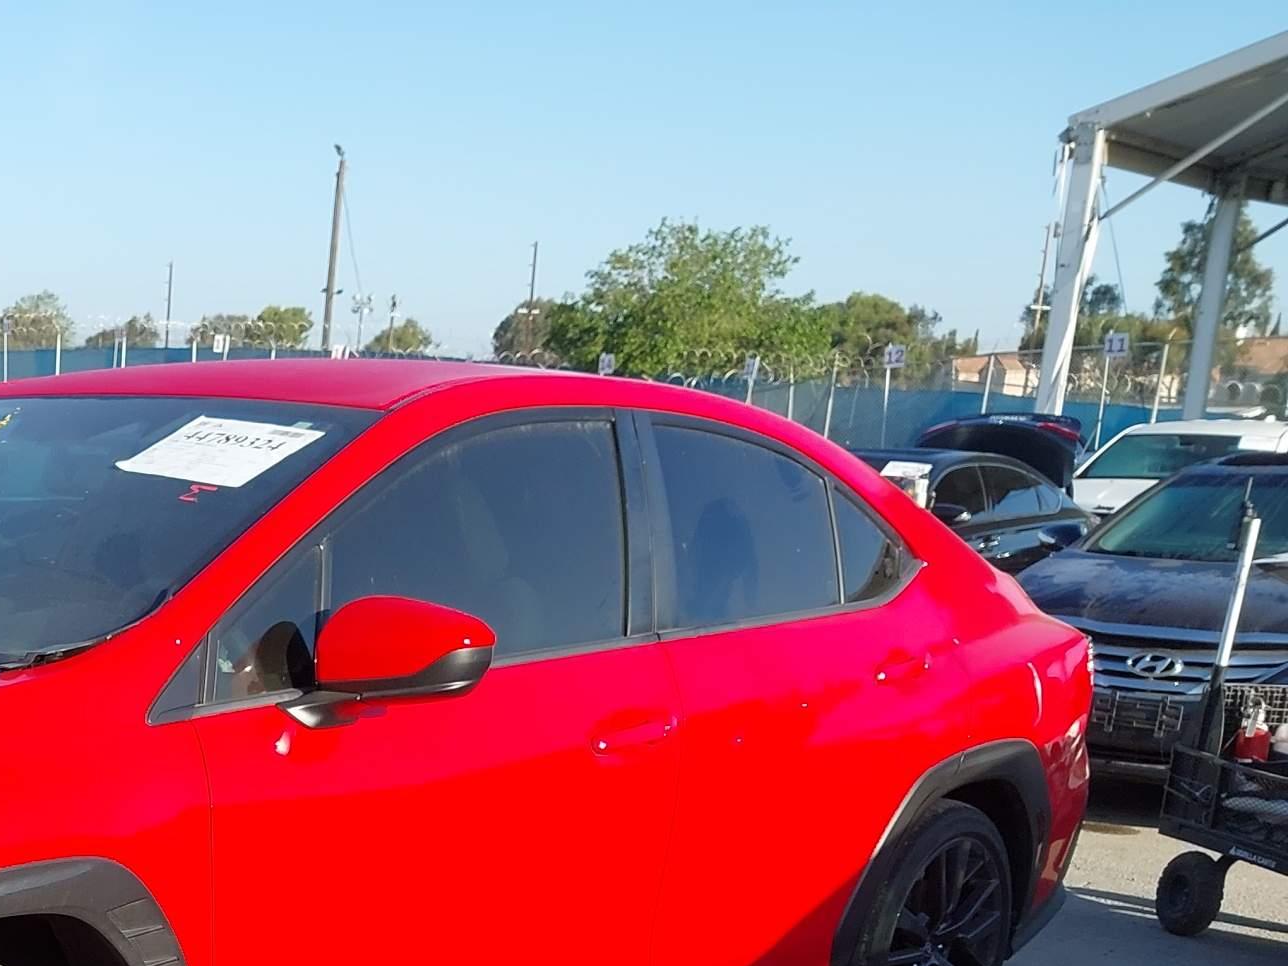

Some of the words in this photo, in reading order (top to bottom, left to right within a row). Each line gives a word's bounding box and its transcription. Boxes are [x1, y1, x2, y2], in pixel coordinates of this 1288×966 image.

[1107, 337, 1125, 353] 11
[887, 349, 904, 364] 12
[184, 430, 286, 451] 44789324
